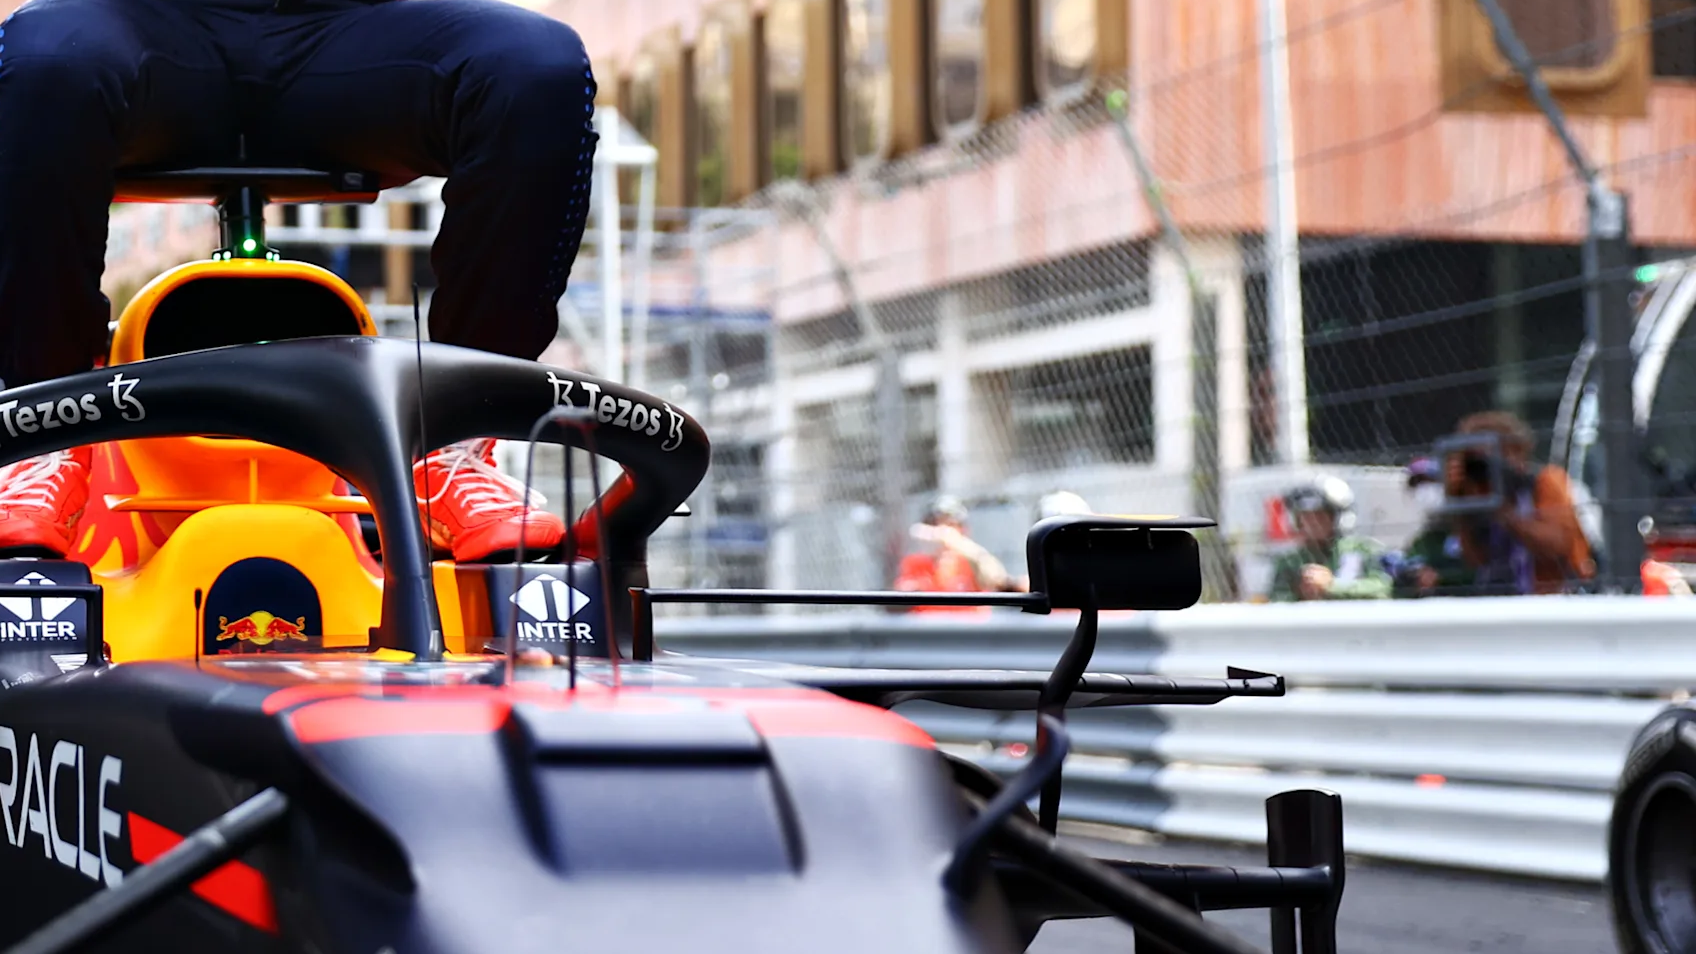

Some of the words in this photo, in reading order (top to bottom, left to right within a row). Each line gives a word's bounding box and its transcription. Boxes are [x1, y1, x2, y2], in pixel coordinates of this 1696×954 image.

[579, 381, 662, 437] Tezos
[0, 621, 76, 638] INTER
[517, 622, 594, 640] INTER
